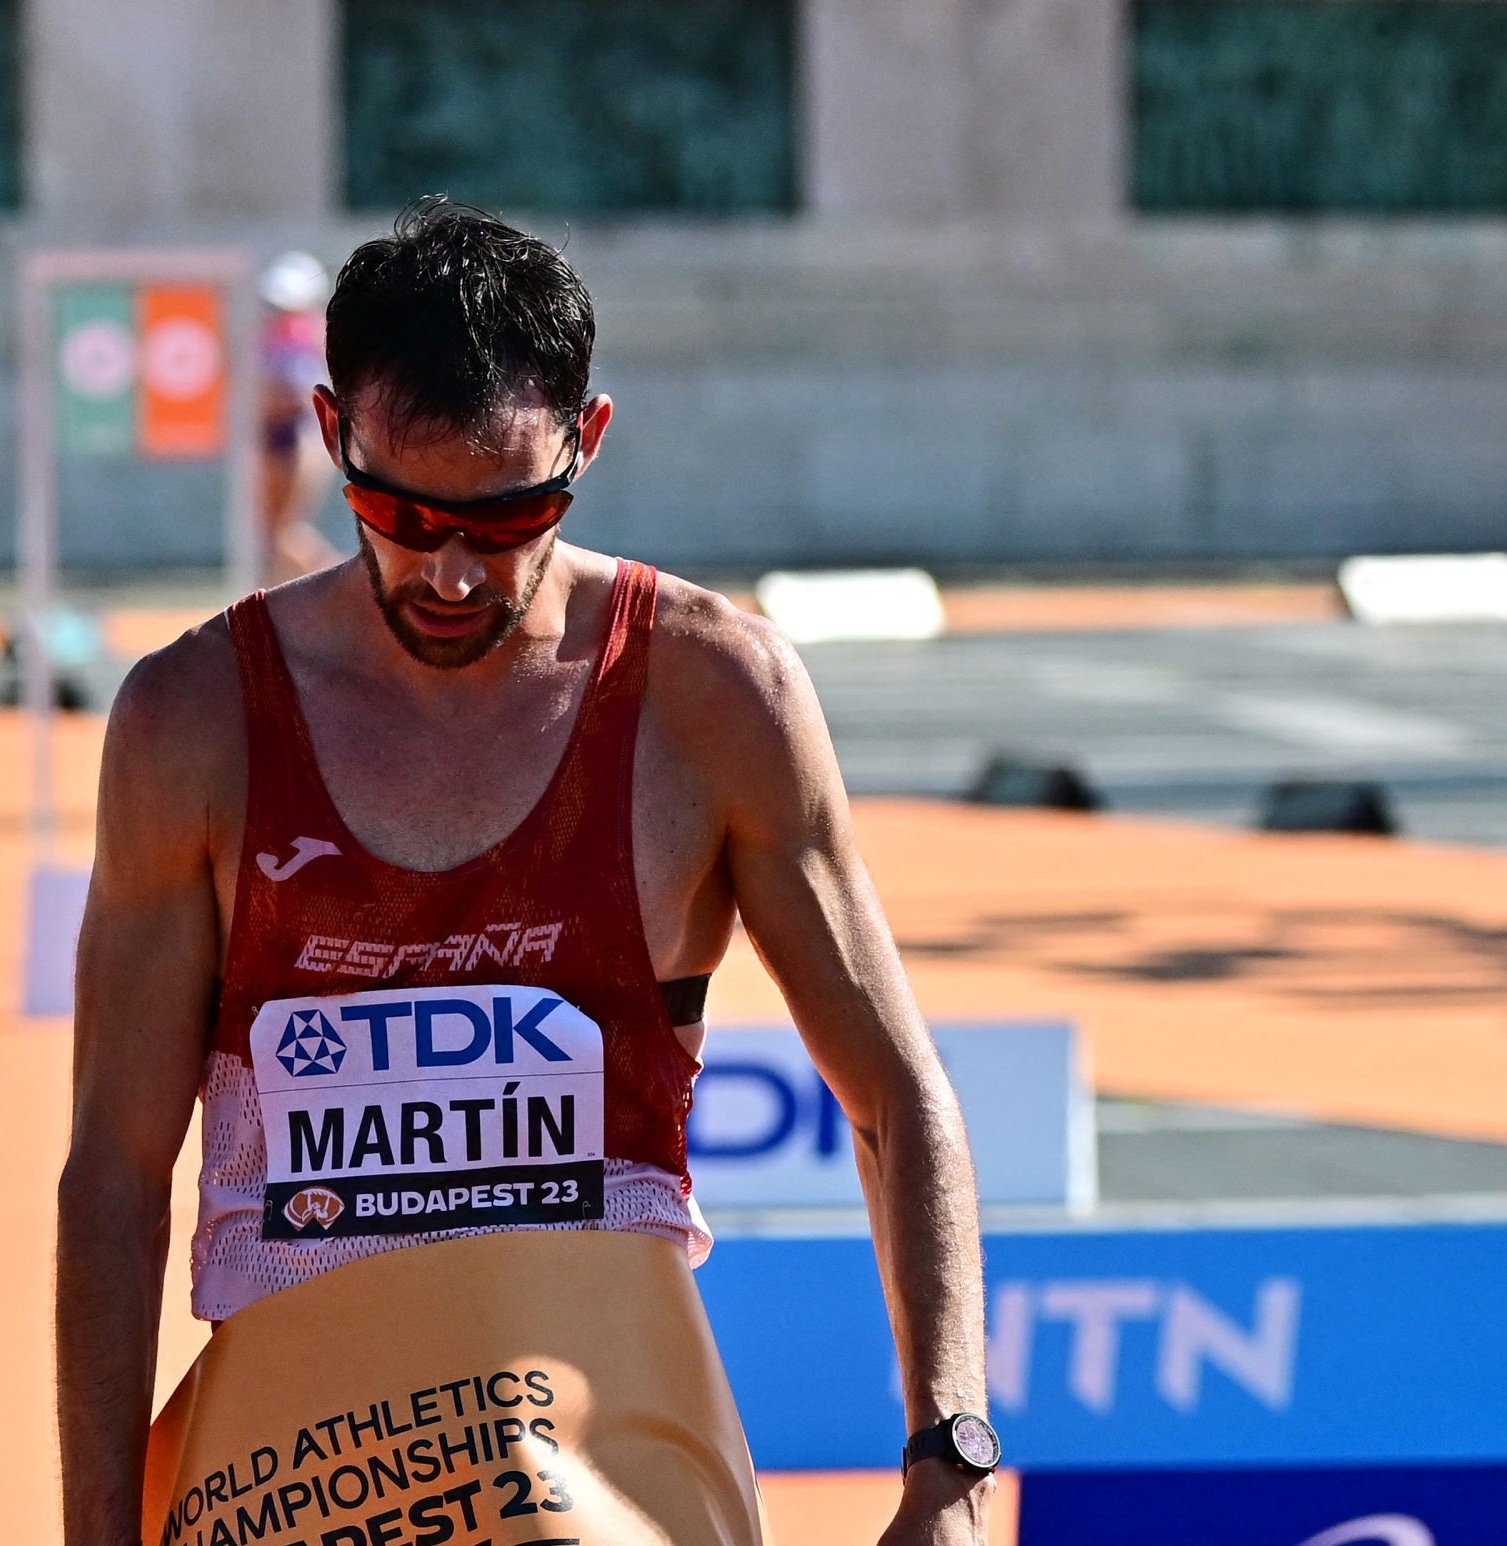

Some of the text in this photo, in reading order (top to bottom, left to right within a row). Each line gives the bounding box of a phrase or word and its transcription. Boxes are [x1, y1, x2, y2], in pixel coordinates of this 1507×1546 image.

[294, 922, 563, 979] ESPAÑA
[341, 997, 574, 1072] TDK
[287, 1081, 577, 1175] MARTÍN
[355, 1179, 580, 1217] BUDAPEST 23
[292, 1370, 556, 1470] ATHLETICS
[492, 1468, 576, 1521] 23
